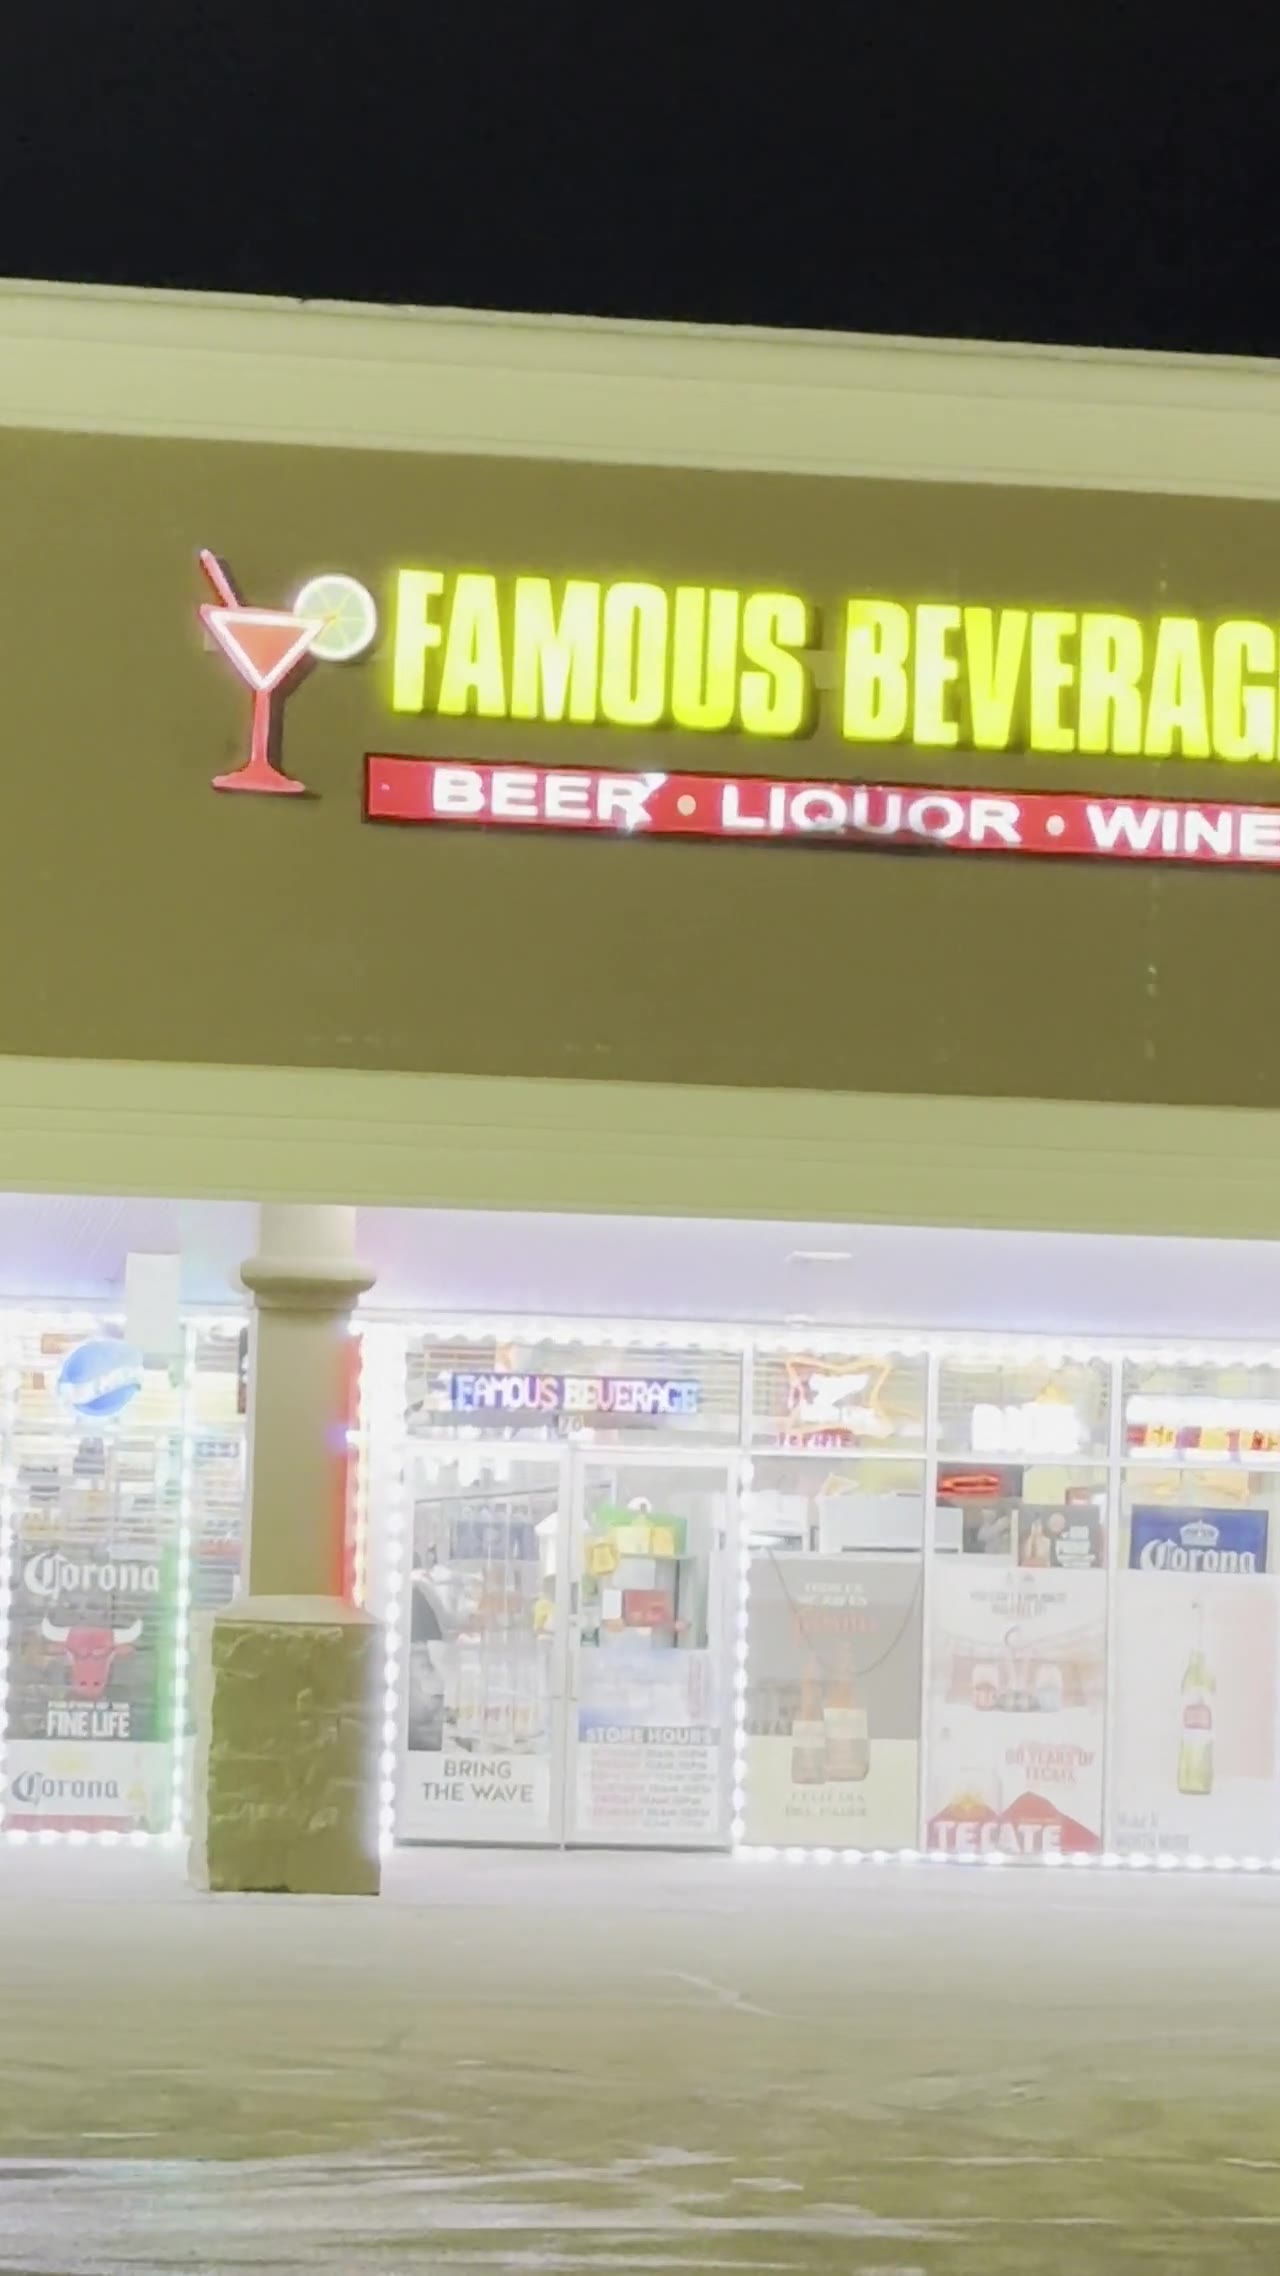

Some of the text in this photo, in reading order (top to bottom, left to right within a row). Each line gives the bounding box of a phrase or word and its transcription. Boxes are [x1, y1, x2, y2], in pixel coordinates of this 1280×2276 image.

[393, 568, 1280, 763] FAMOUS BEVERAG
[432, 767, 656, 826] BEER
[721, 784, 1021, 844] LIQUOR
[456, 1375, 700, 1413] FAMOUS BEVERAGE
[1140, 1538, 1256, 1574] Corona
[23, 1551, 160, 1601] Corona
[48, 1711, 130, 1738] FINE LIFE
[585, 1726, 712, 1745] STORE HOURS
[443, 1759, 512, 1779] BRING
[11, 1769, 119, 1806] Corona
[422, 1781, 534, 1804] THE WAVE
[932, 1821, 1062, 1855] TECATE
